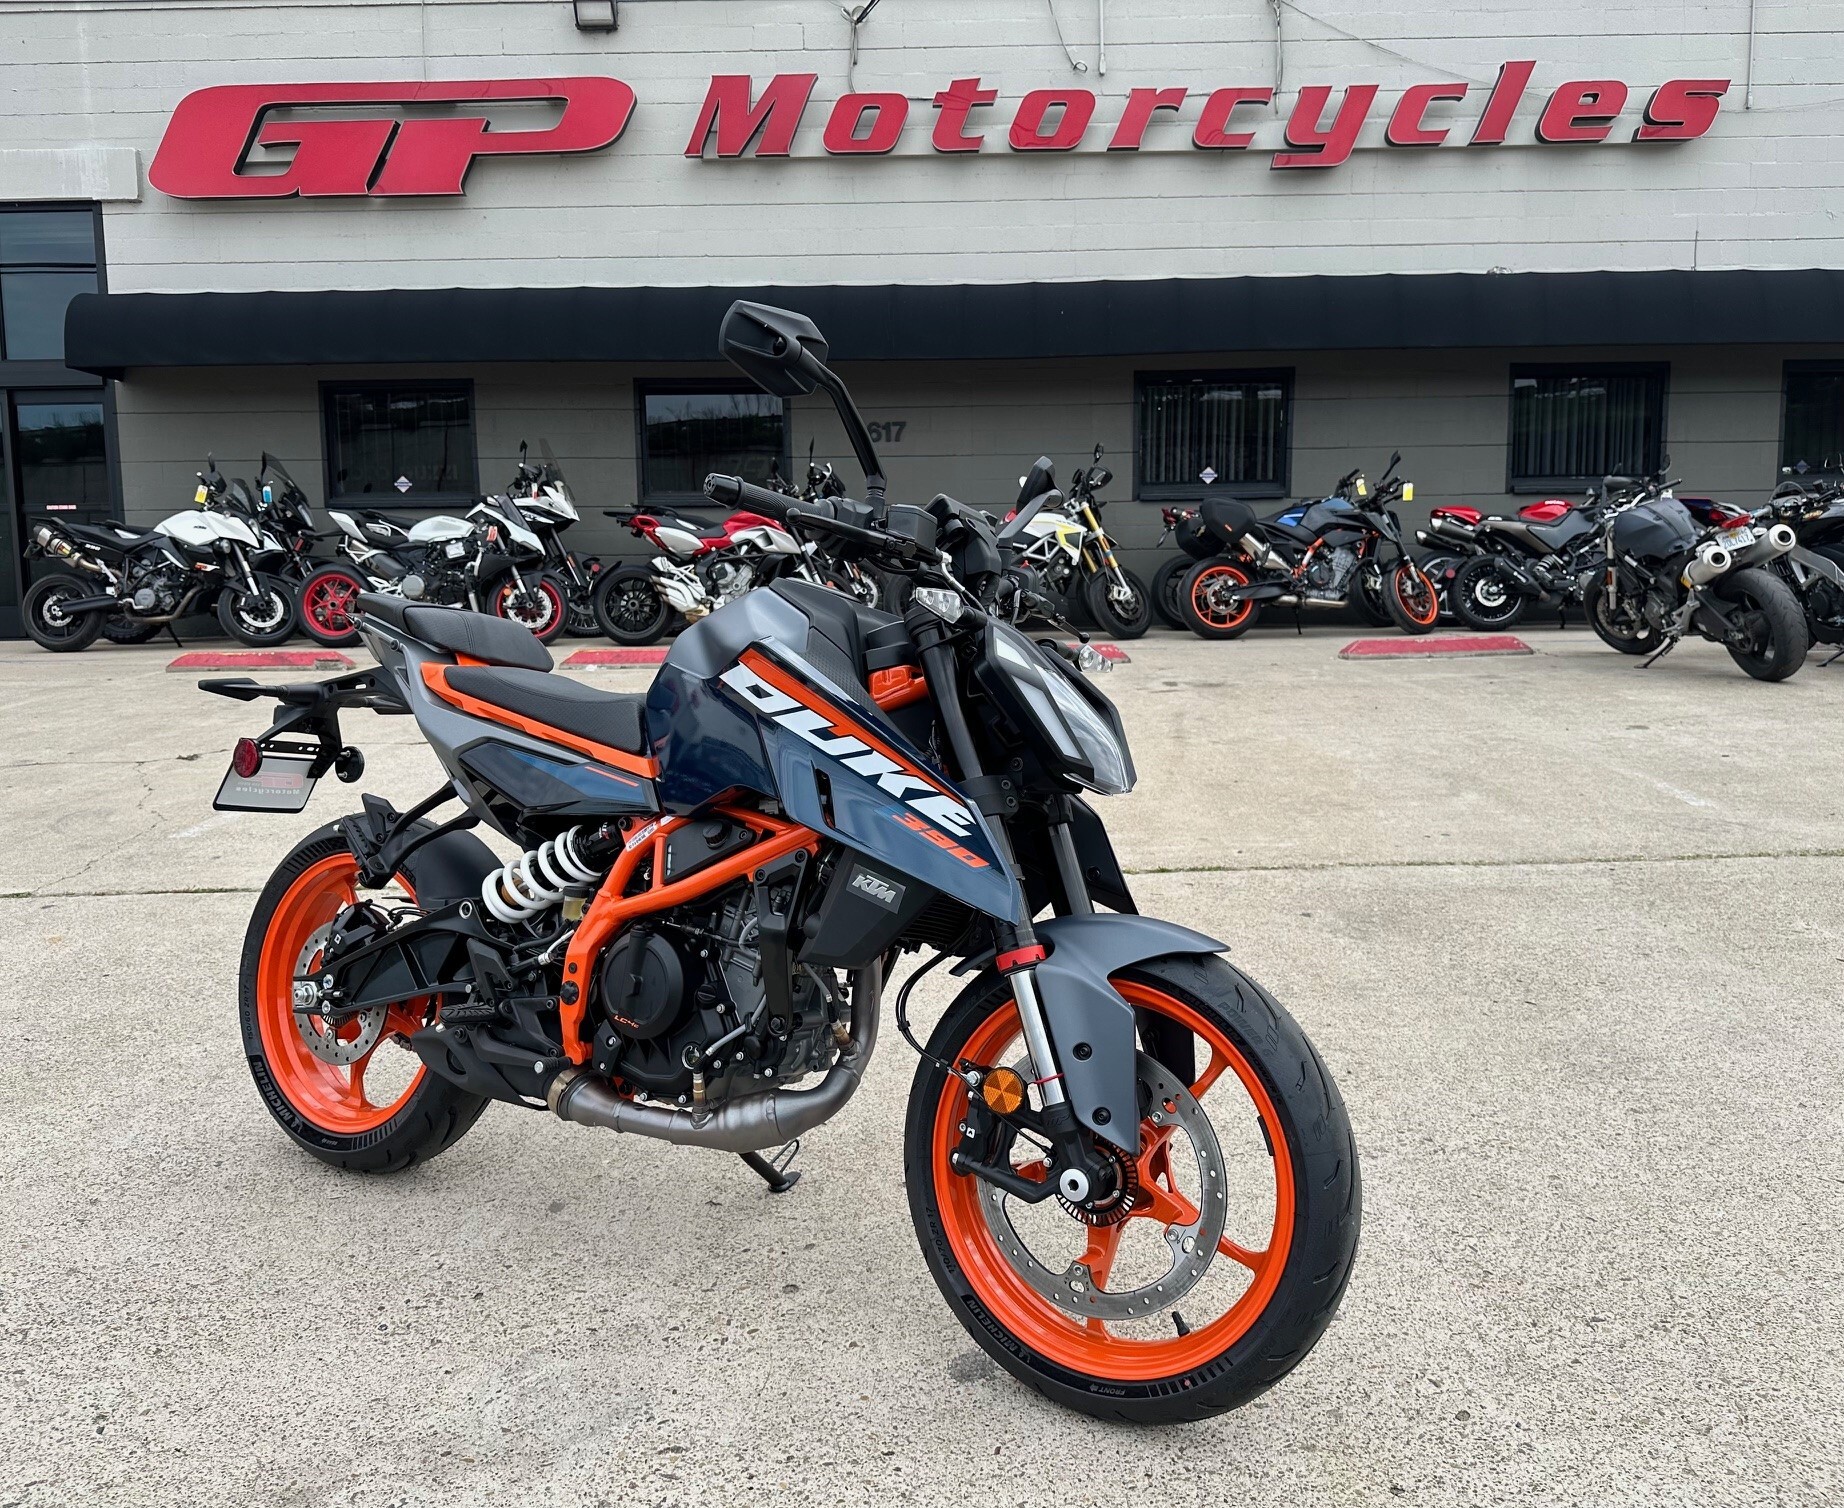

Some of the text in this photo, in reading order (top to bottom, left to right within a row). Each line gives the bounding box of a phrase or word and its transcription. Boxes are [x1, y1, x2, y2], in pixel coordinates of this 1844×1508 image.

[148, 60, 1731, 199] GP Motorcycles
[719, 660, 976, 837] DUKE
[892, 811, 990, 869] 390
[852, 873, 897, 904] KTM
[253, 1061, 292, 1121] MICHELIN
[936, 1240, 956, 1273] 110/70
[966, 1300, 1018, 1351] MICHELIN
[1098, 1386, 1126, 1396] FRONT
